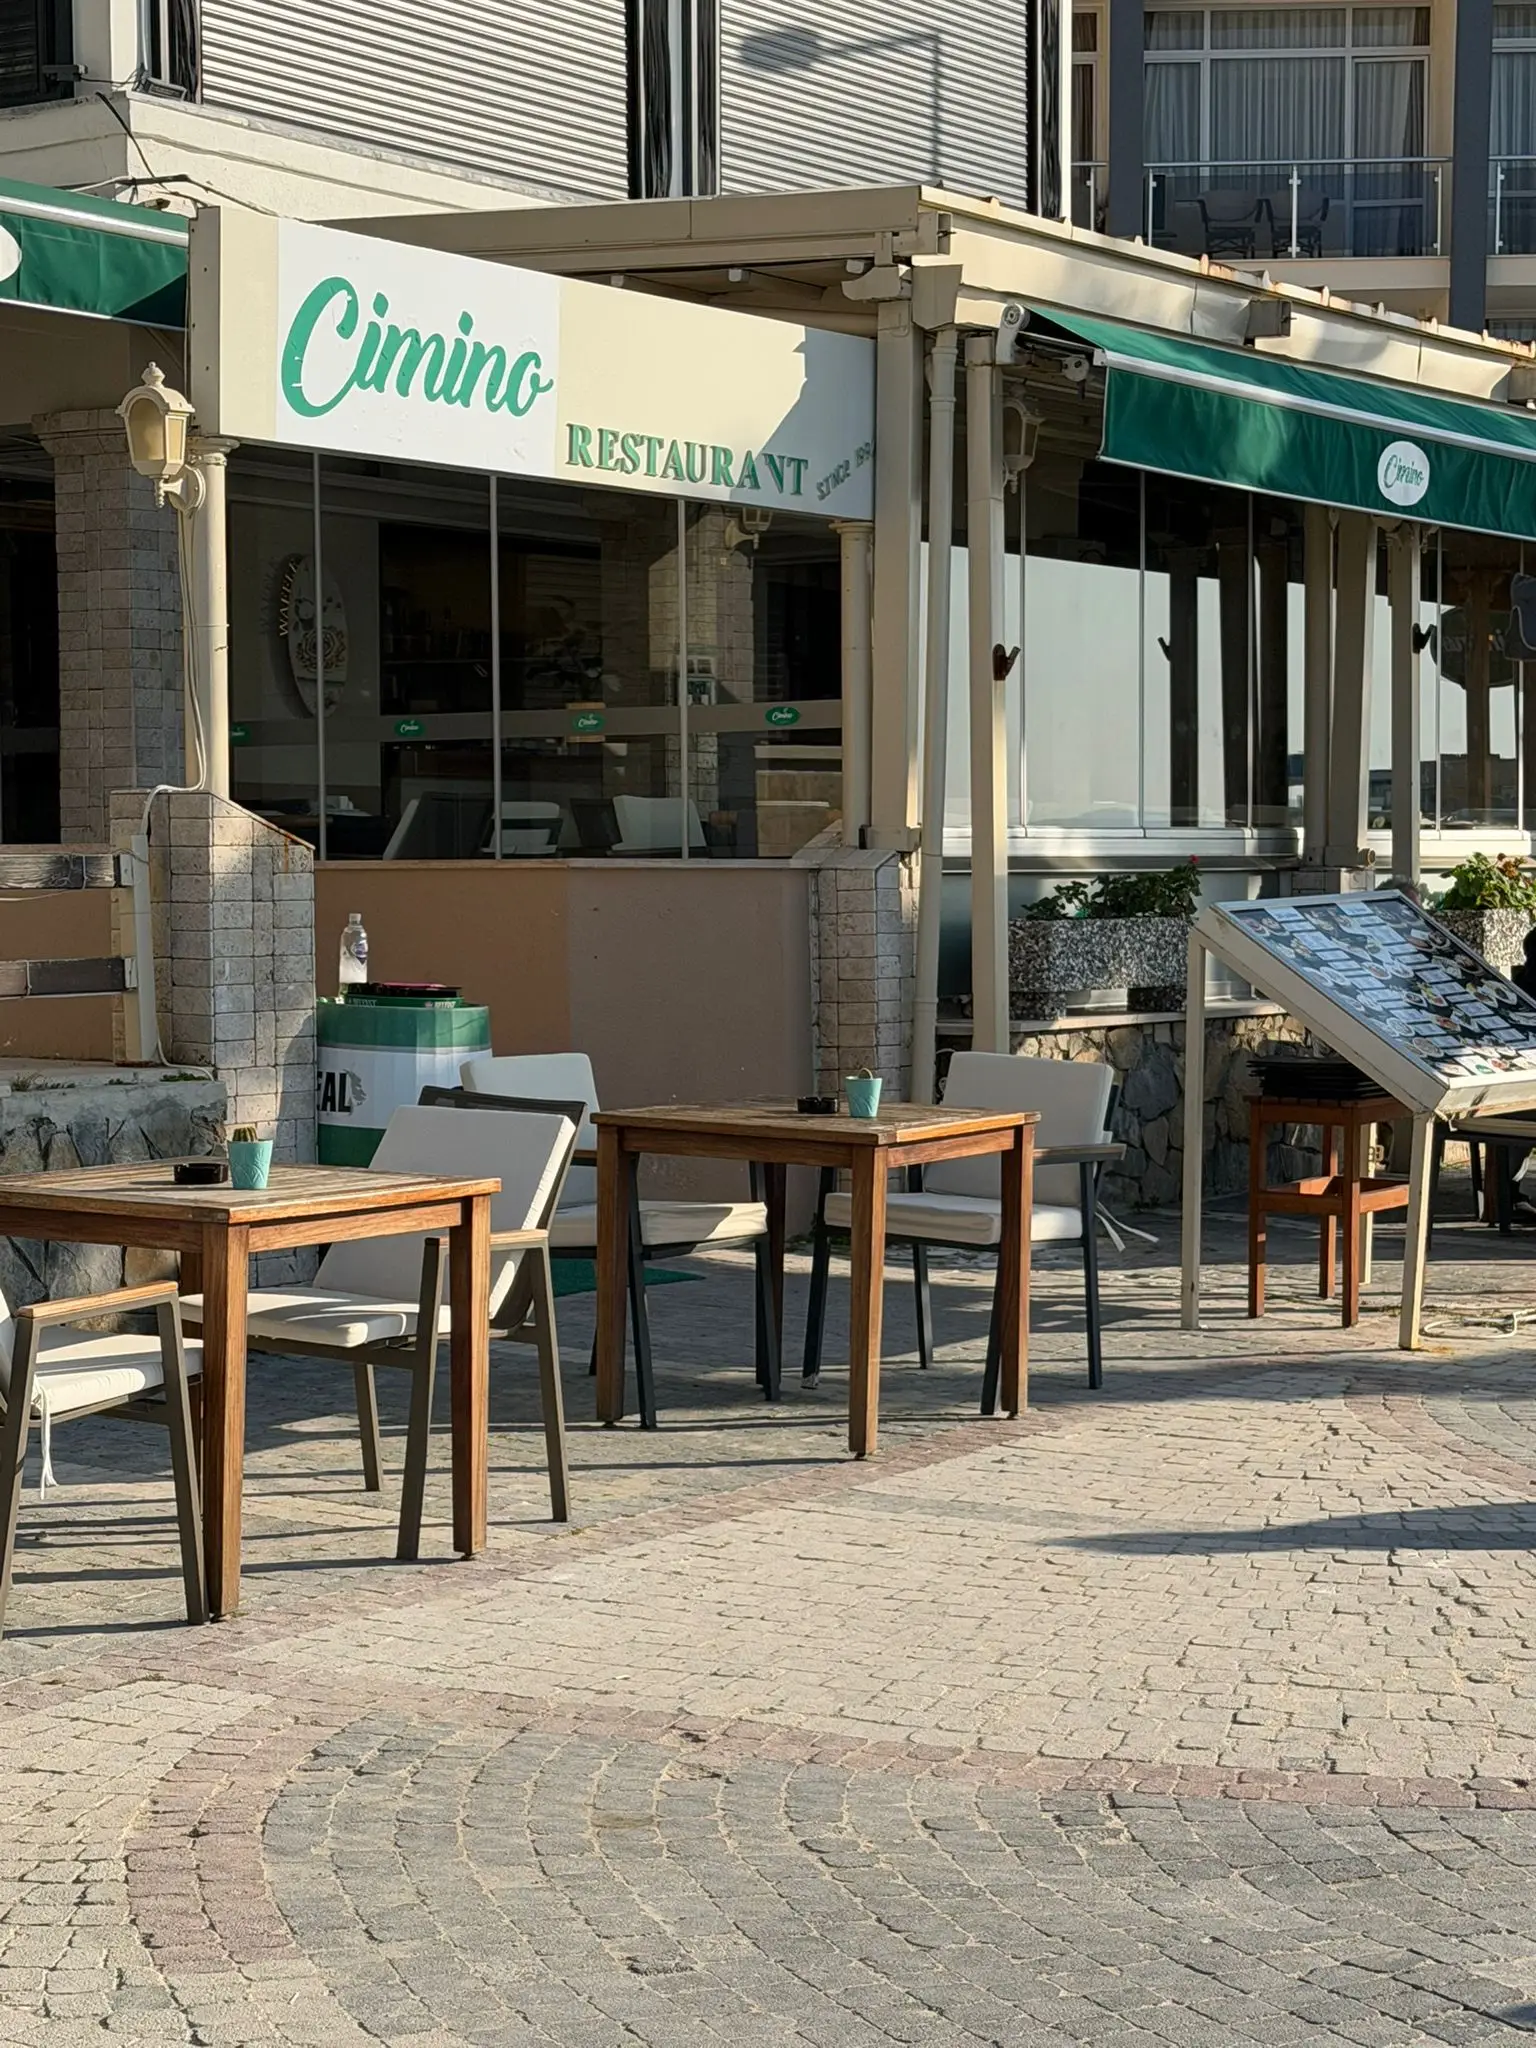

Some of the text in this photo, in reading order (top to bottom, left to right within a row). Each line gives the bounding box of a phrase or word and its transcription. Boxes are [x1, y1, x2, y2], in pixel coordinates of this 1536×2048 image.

[281, 276, 554, 417] Cimino
[565, 423, 808, 495] RESTAURANT
[1384, 454, 1424, 488] Cimino
